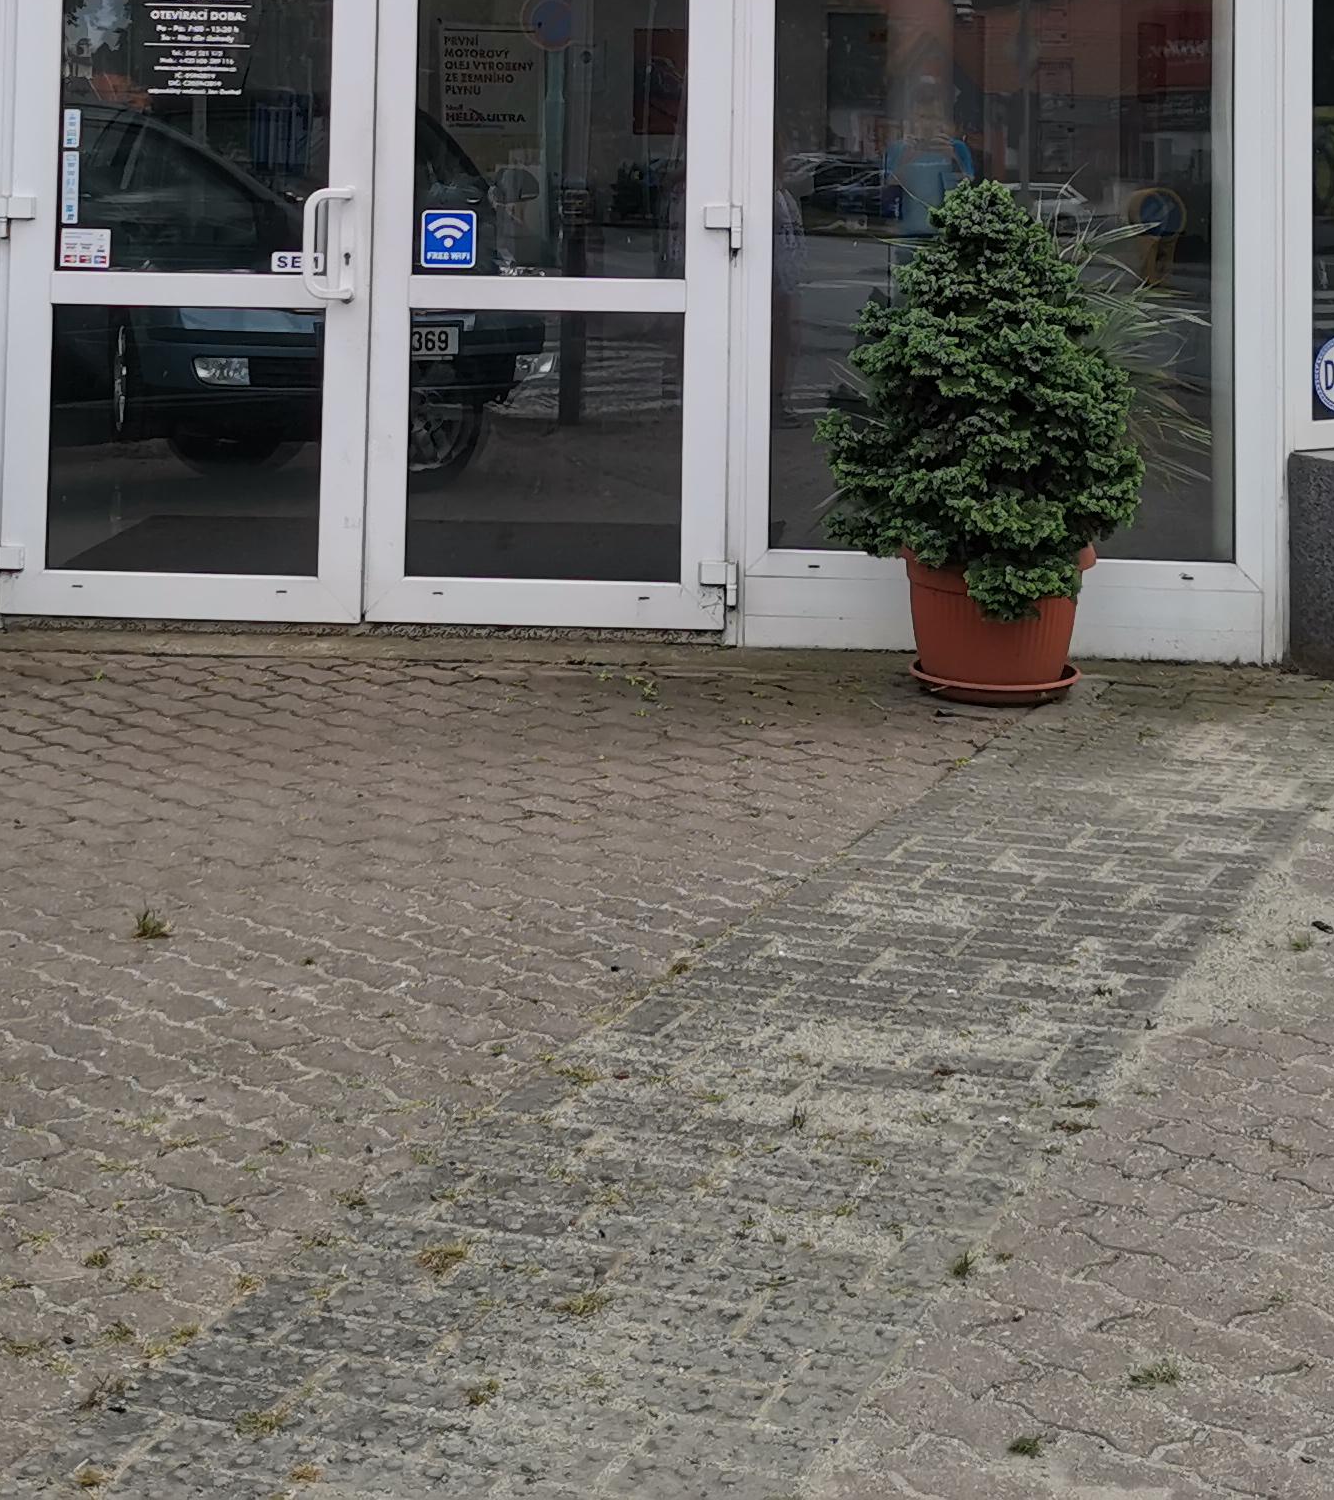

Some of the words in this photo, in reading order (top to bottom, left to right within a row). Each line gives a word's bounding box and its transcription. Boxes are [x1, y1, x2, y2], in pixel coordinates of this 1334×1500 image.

[150, 8, 208, 20] OTEVÍRACÍ
[444, 34, 479, 46] PRVNÍ
[444, 47, 510, 59] MOTOROVÝ
[445, 60, 470, 70] OLEJ
[473, 59, 534, 71] VYROBENÝ
[445, 73, 458, 83] ZE
[460, 72, 514, 83] ZEMNÍHO
[445, 85, 481, 95] PLYNU
[487, 113, 527, 123] ULTRA
[277, 256, 318, 269] SE
[412, 331, 449, 351] 369
